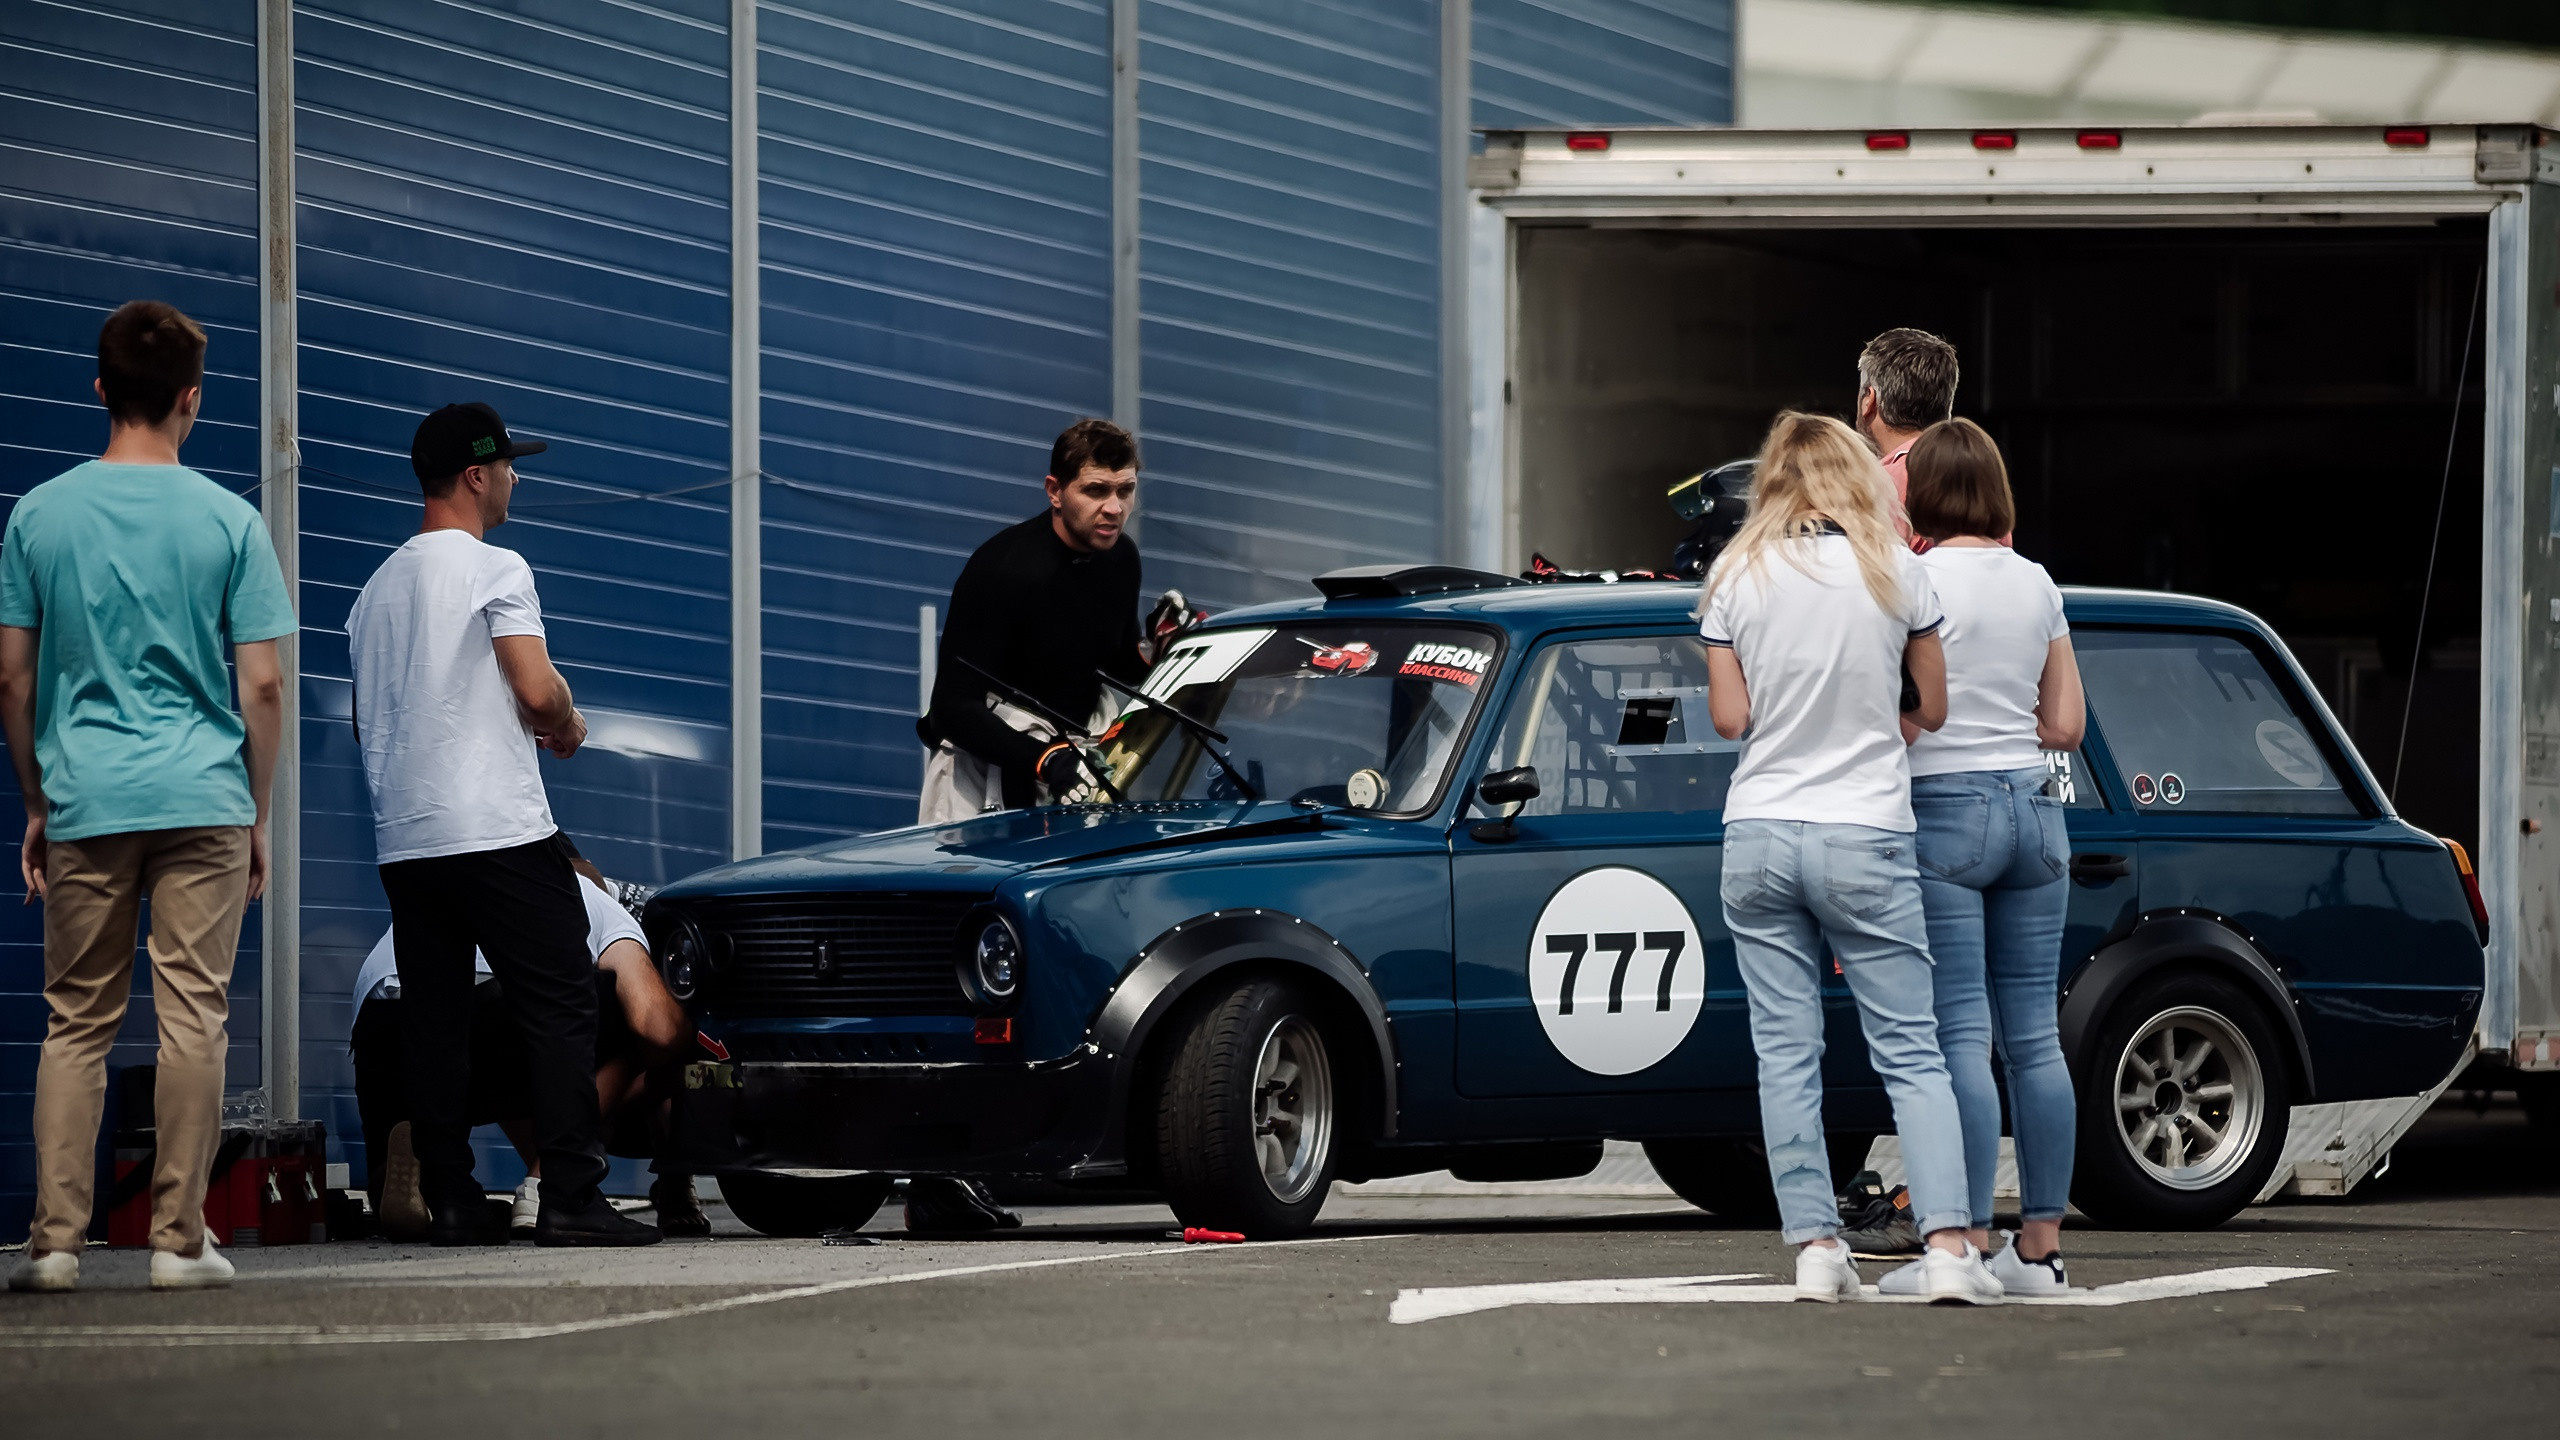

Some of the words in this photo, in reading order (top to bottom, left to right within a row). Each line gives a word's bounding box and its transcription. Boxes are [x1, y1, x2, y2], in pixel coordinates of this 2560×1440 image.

[1405, 643, 1492, 674] КУБОК
[1399, 663, 1478, 687] КЛАССИКИ
[1545, 930, 1686, 1015] 777
